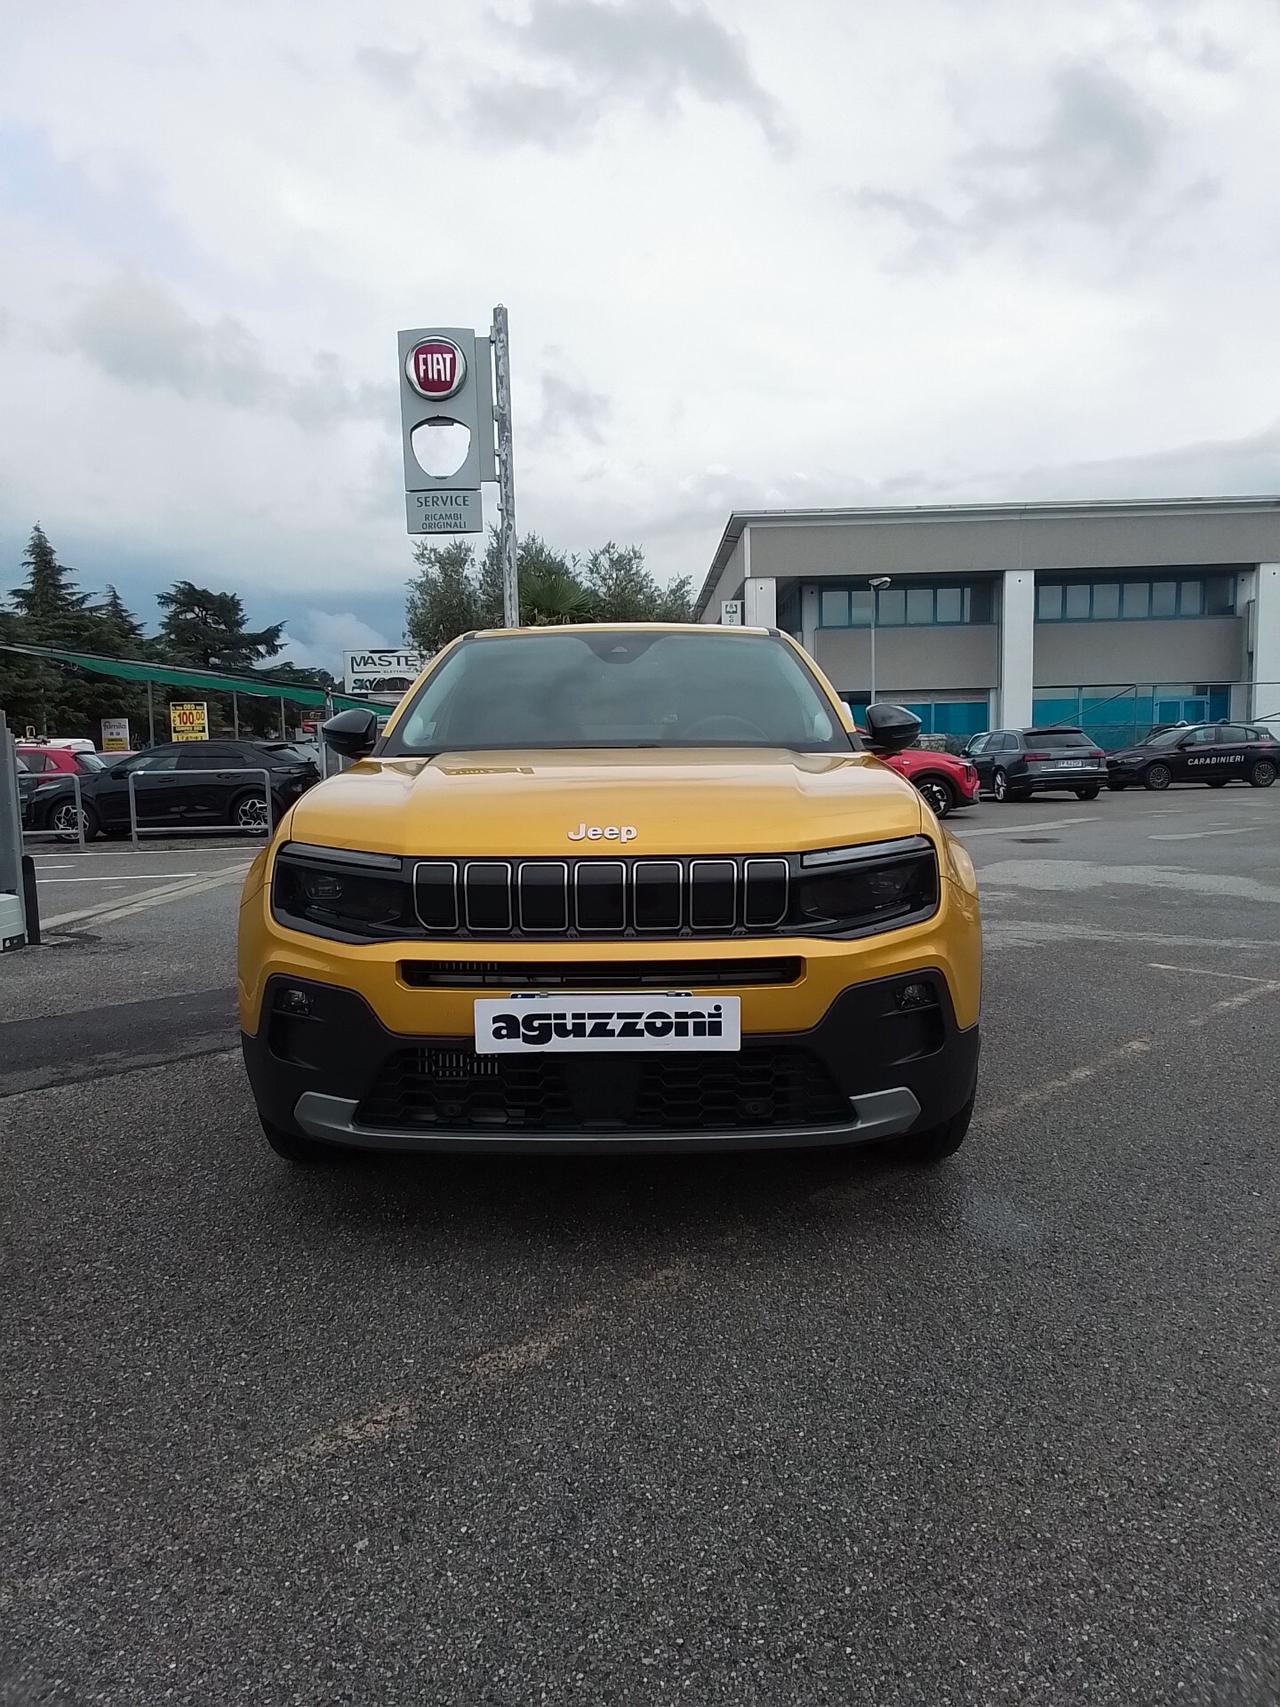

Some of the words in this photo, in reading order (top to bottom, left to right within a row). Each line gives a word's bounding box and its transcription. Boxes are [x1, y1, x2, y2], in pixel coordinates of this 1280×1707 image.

[418, 353, 453, 382] FIAT
[416, 495, 470, 508] SERVICE
[424, 512, 462, 521] RICAMBI
[421, 521, 467, 530] ORIGINALI
[350, 655, 418, 667] MASTE
[1187, 755, 1245, 766] CARABINIERI
[567, 823, 637, 843] Jeep
[491, 1004, 723, 1046] aguzzoni
